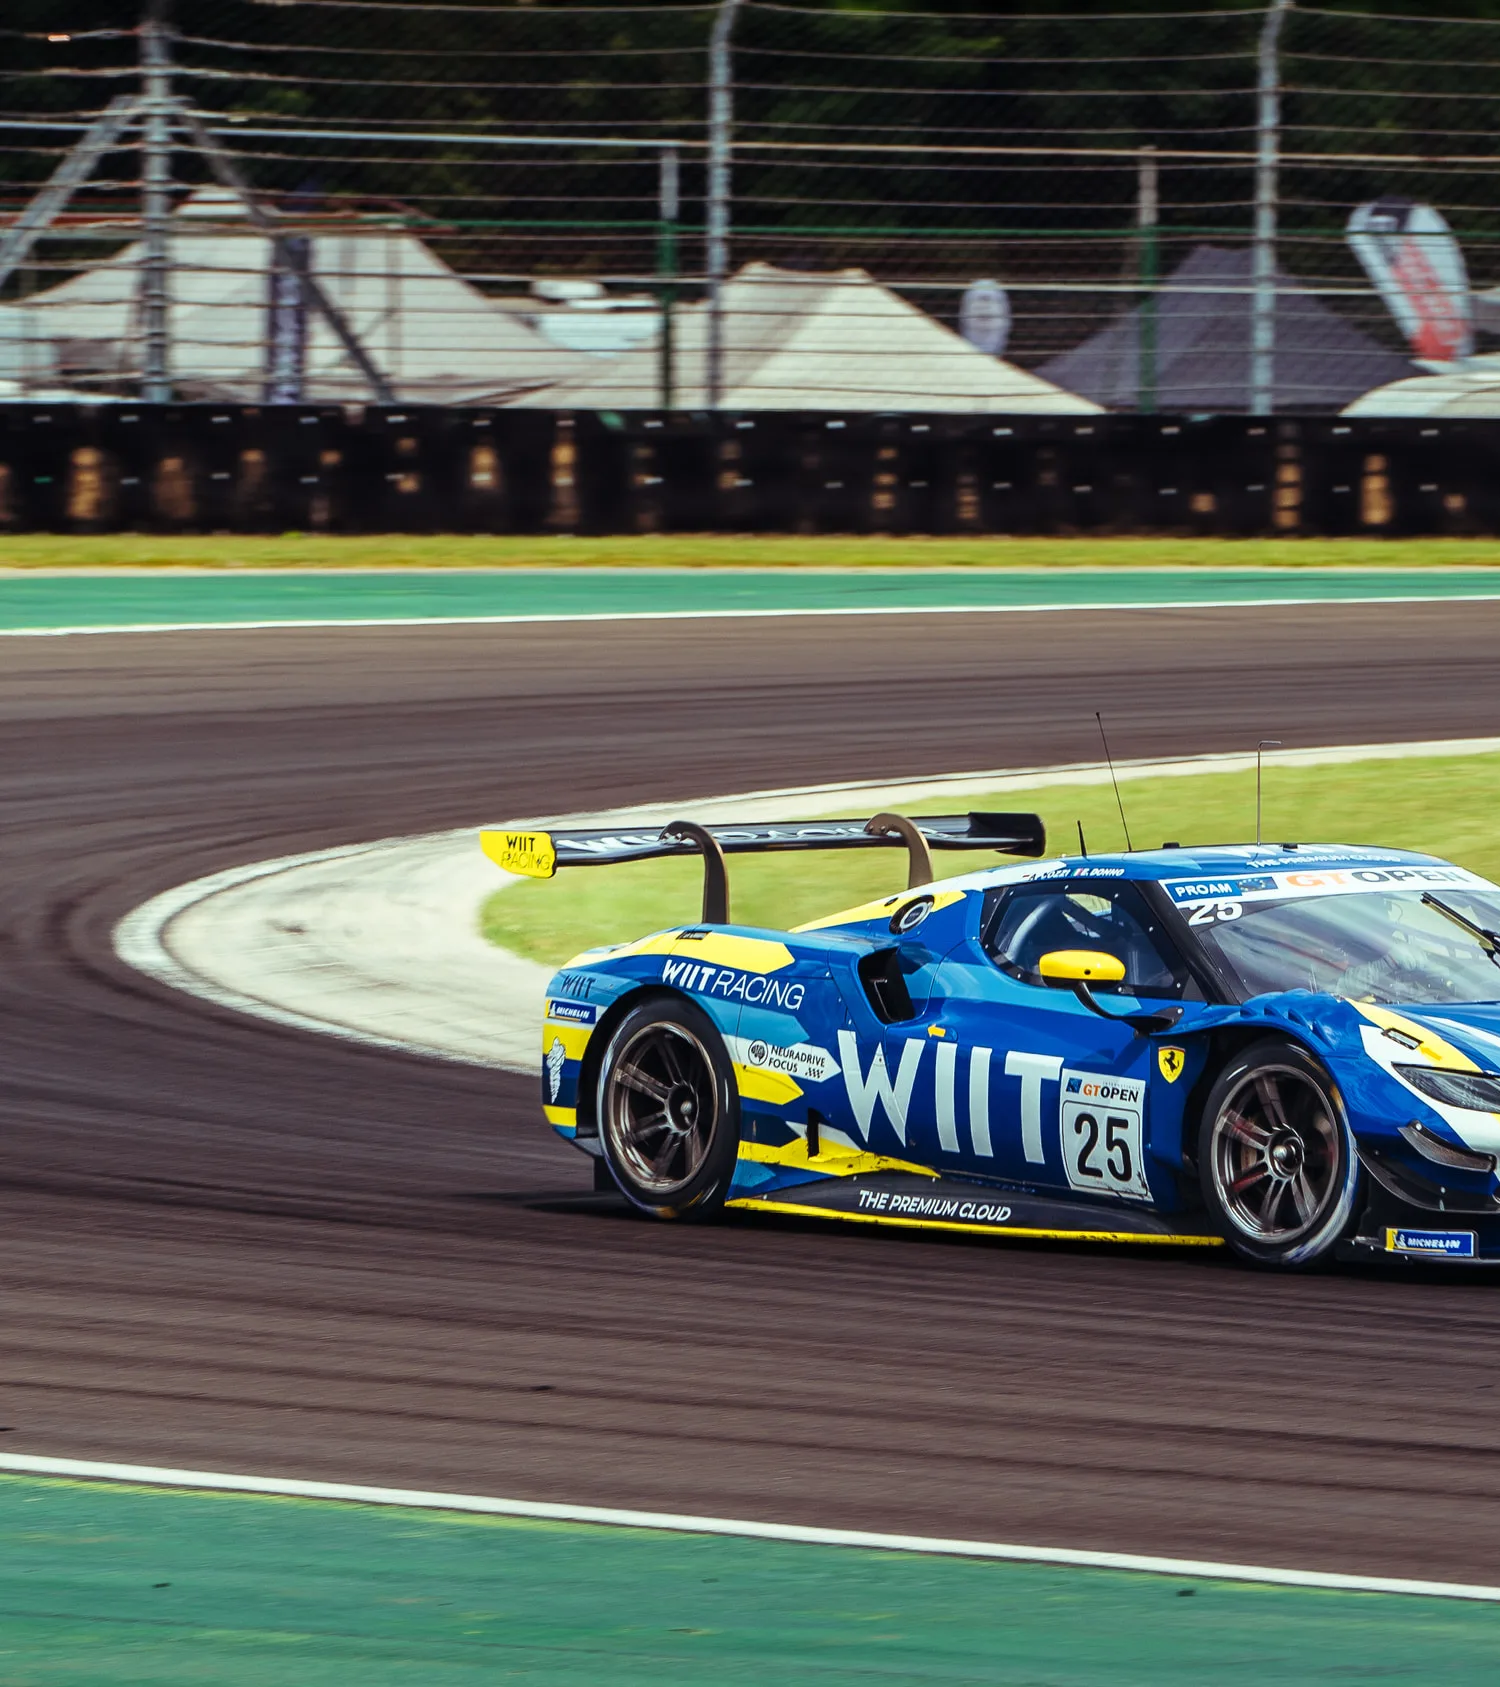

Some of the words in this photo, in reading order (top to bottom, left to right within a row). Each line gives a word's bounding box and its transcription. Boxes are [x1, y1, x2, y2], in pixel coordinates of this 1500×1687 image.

[506, 835, 536, 852] WIIT
[501, 850, 550, 871] RACING
[1175, 882, 1233, 898] PROAM
[1188, 901, 1243, 927] 25
[561, 974, 596, 999] WIIT
[711, 970, 805, 1011] RACING
[556, 1006, 590, 1020] MICHELIN
[768, 1057, 798, 1073] FOCUS
[770, 1045, 825, 1068] NEURADRIVE
[837, 1028, 1064, 1165] WIIT
[1074, 1112, 1132, 1182] 25
[859, 1190, 889, 1211] THE
[889, 1194, 959, 1218] PREMIUM
[959, 1204, 1012, 1222] CLOUD
[1408, 1237, 1461, 1249] MICHELIN
